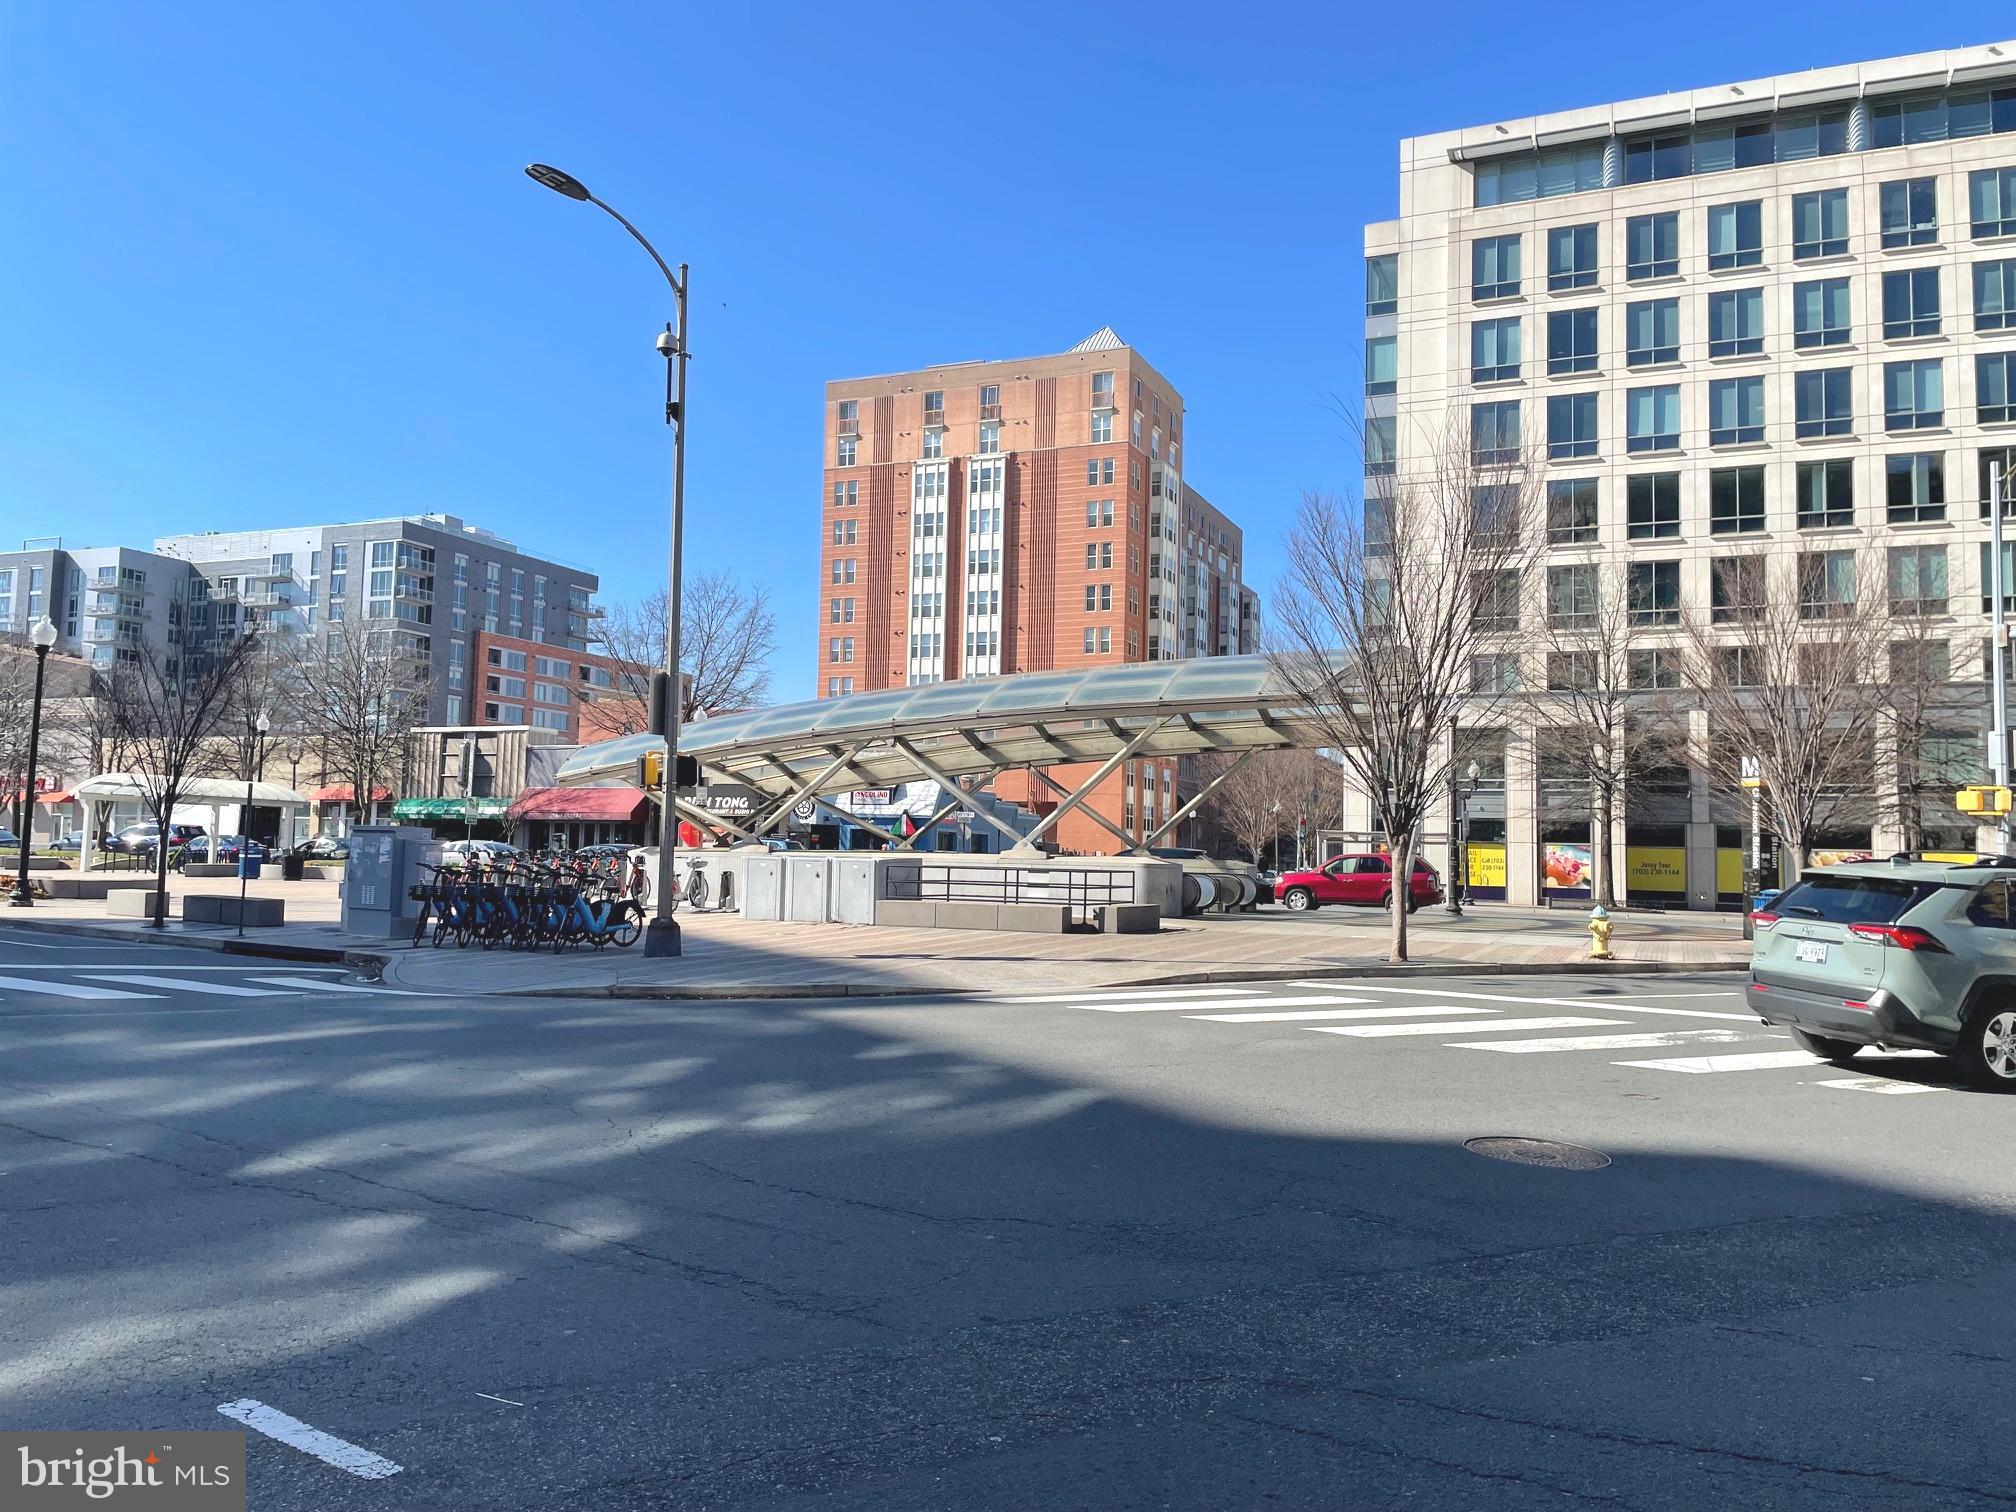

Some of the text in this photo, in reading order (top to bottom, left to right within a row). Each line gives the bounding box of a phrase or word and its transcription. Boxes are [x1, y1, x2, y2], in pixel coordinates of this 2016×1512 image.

[1742, 756, 1759, 777] M
[715, 796, 749, 808] TONG
[1752, 836, 1760, 869] Station
[1632, 868, 1649, 876] (703)
